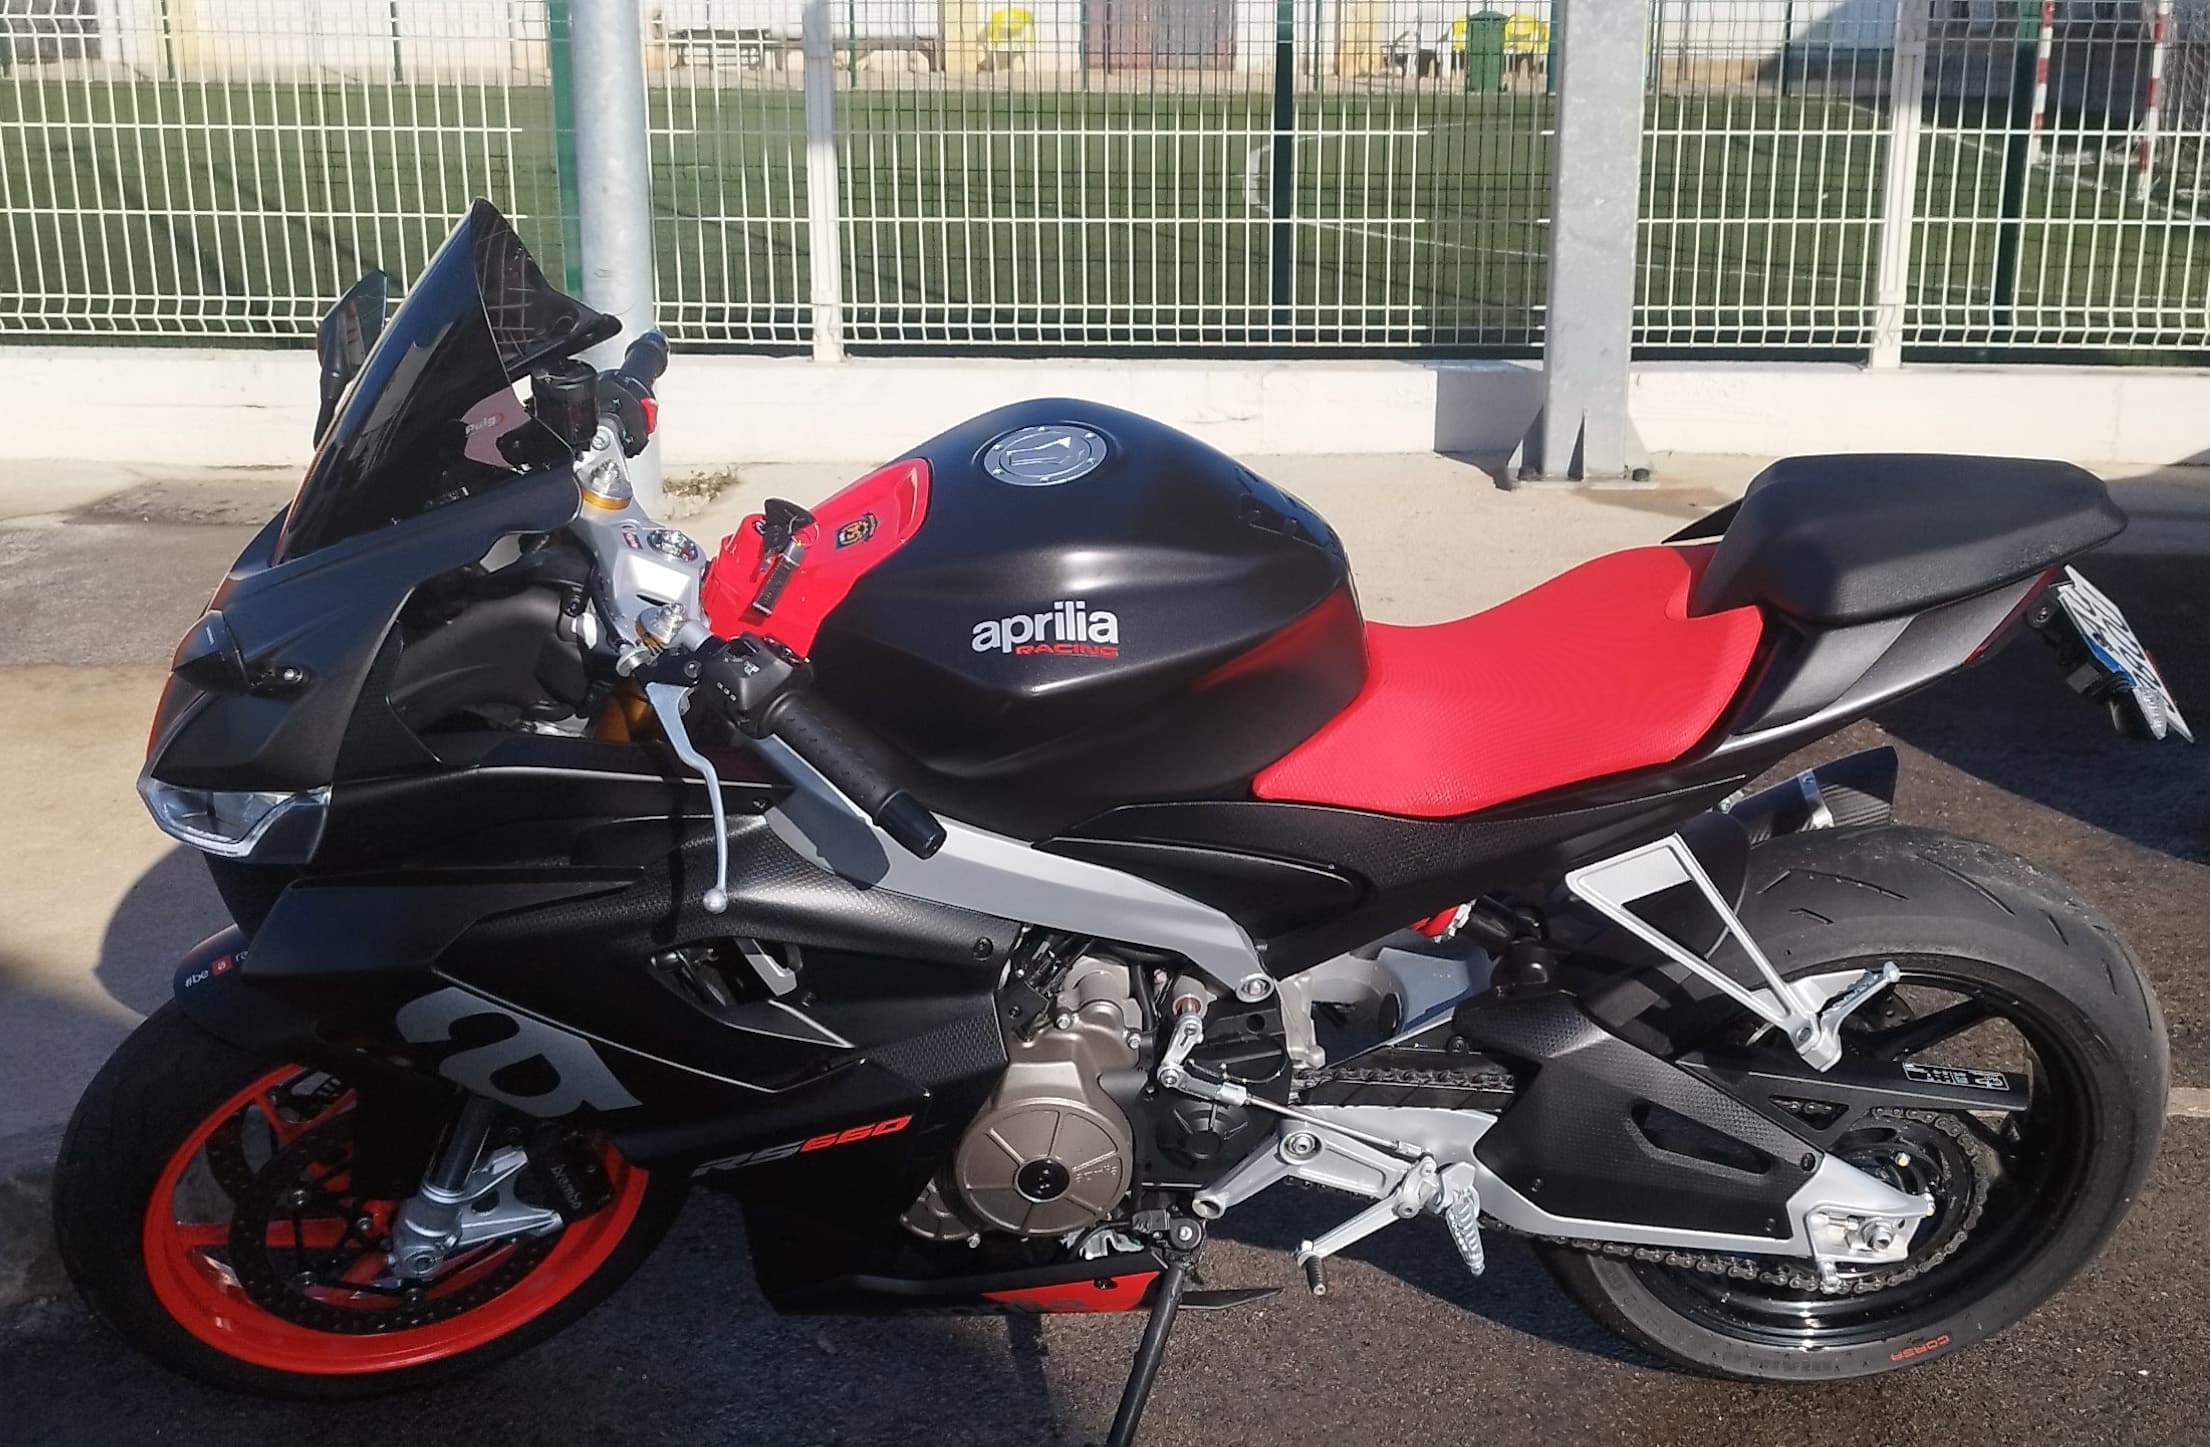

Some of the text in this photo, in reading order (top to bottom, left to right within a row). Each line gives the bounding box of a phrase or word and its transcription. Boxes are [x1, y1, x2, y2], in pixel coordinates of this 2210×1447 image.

[465, 415, 496, 434] Puig
[971, 600, 1119, 654] aprilia
[1015, 643, 1119, 659] RACING
[1889, 1334, 1950, 1361] CORSA
